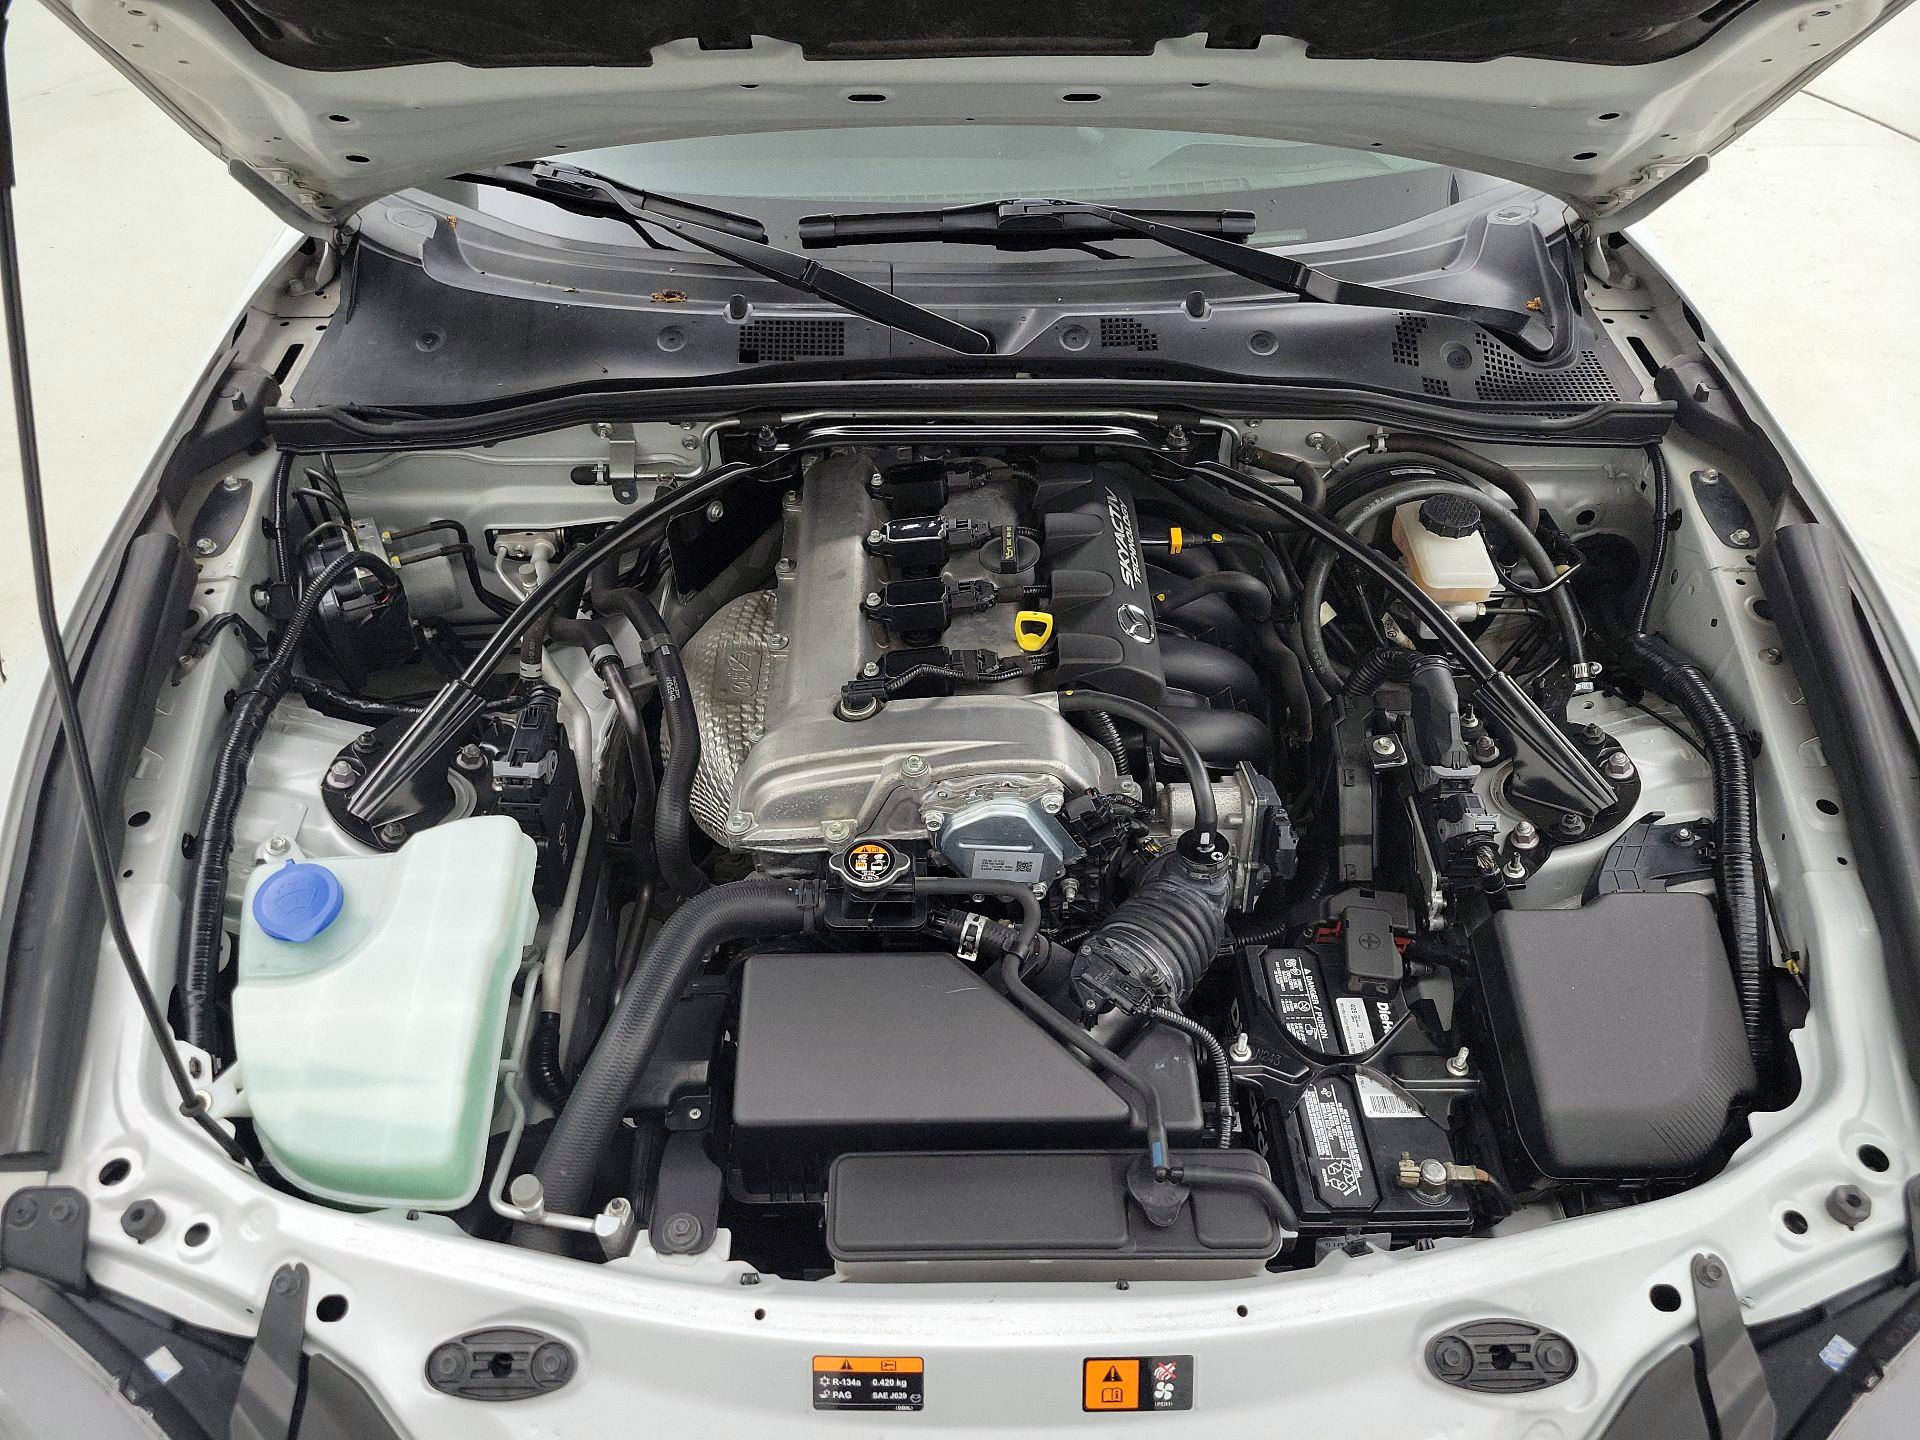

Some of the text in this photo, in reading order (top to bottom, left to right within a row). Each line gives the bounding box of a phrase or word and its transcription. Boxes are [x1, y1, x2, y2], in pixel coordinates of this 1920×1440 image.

[1104, 485, 1135, 591] SKYACTIV
[1119, 497, 1142, 584] TECHNOLOGY
[1305, 975, 1319, 1007] DANGER
[1315, 1012, 1329, 1039] POISON
[832, 1378, 908, 1388] R-134a 0.420 kg
[832, 1391, 852, 1399] PAG
